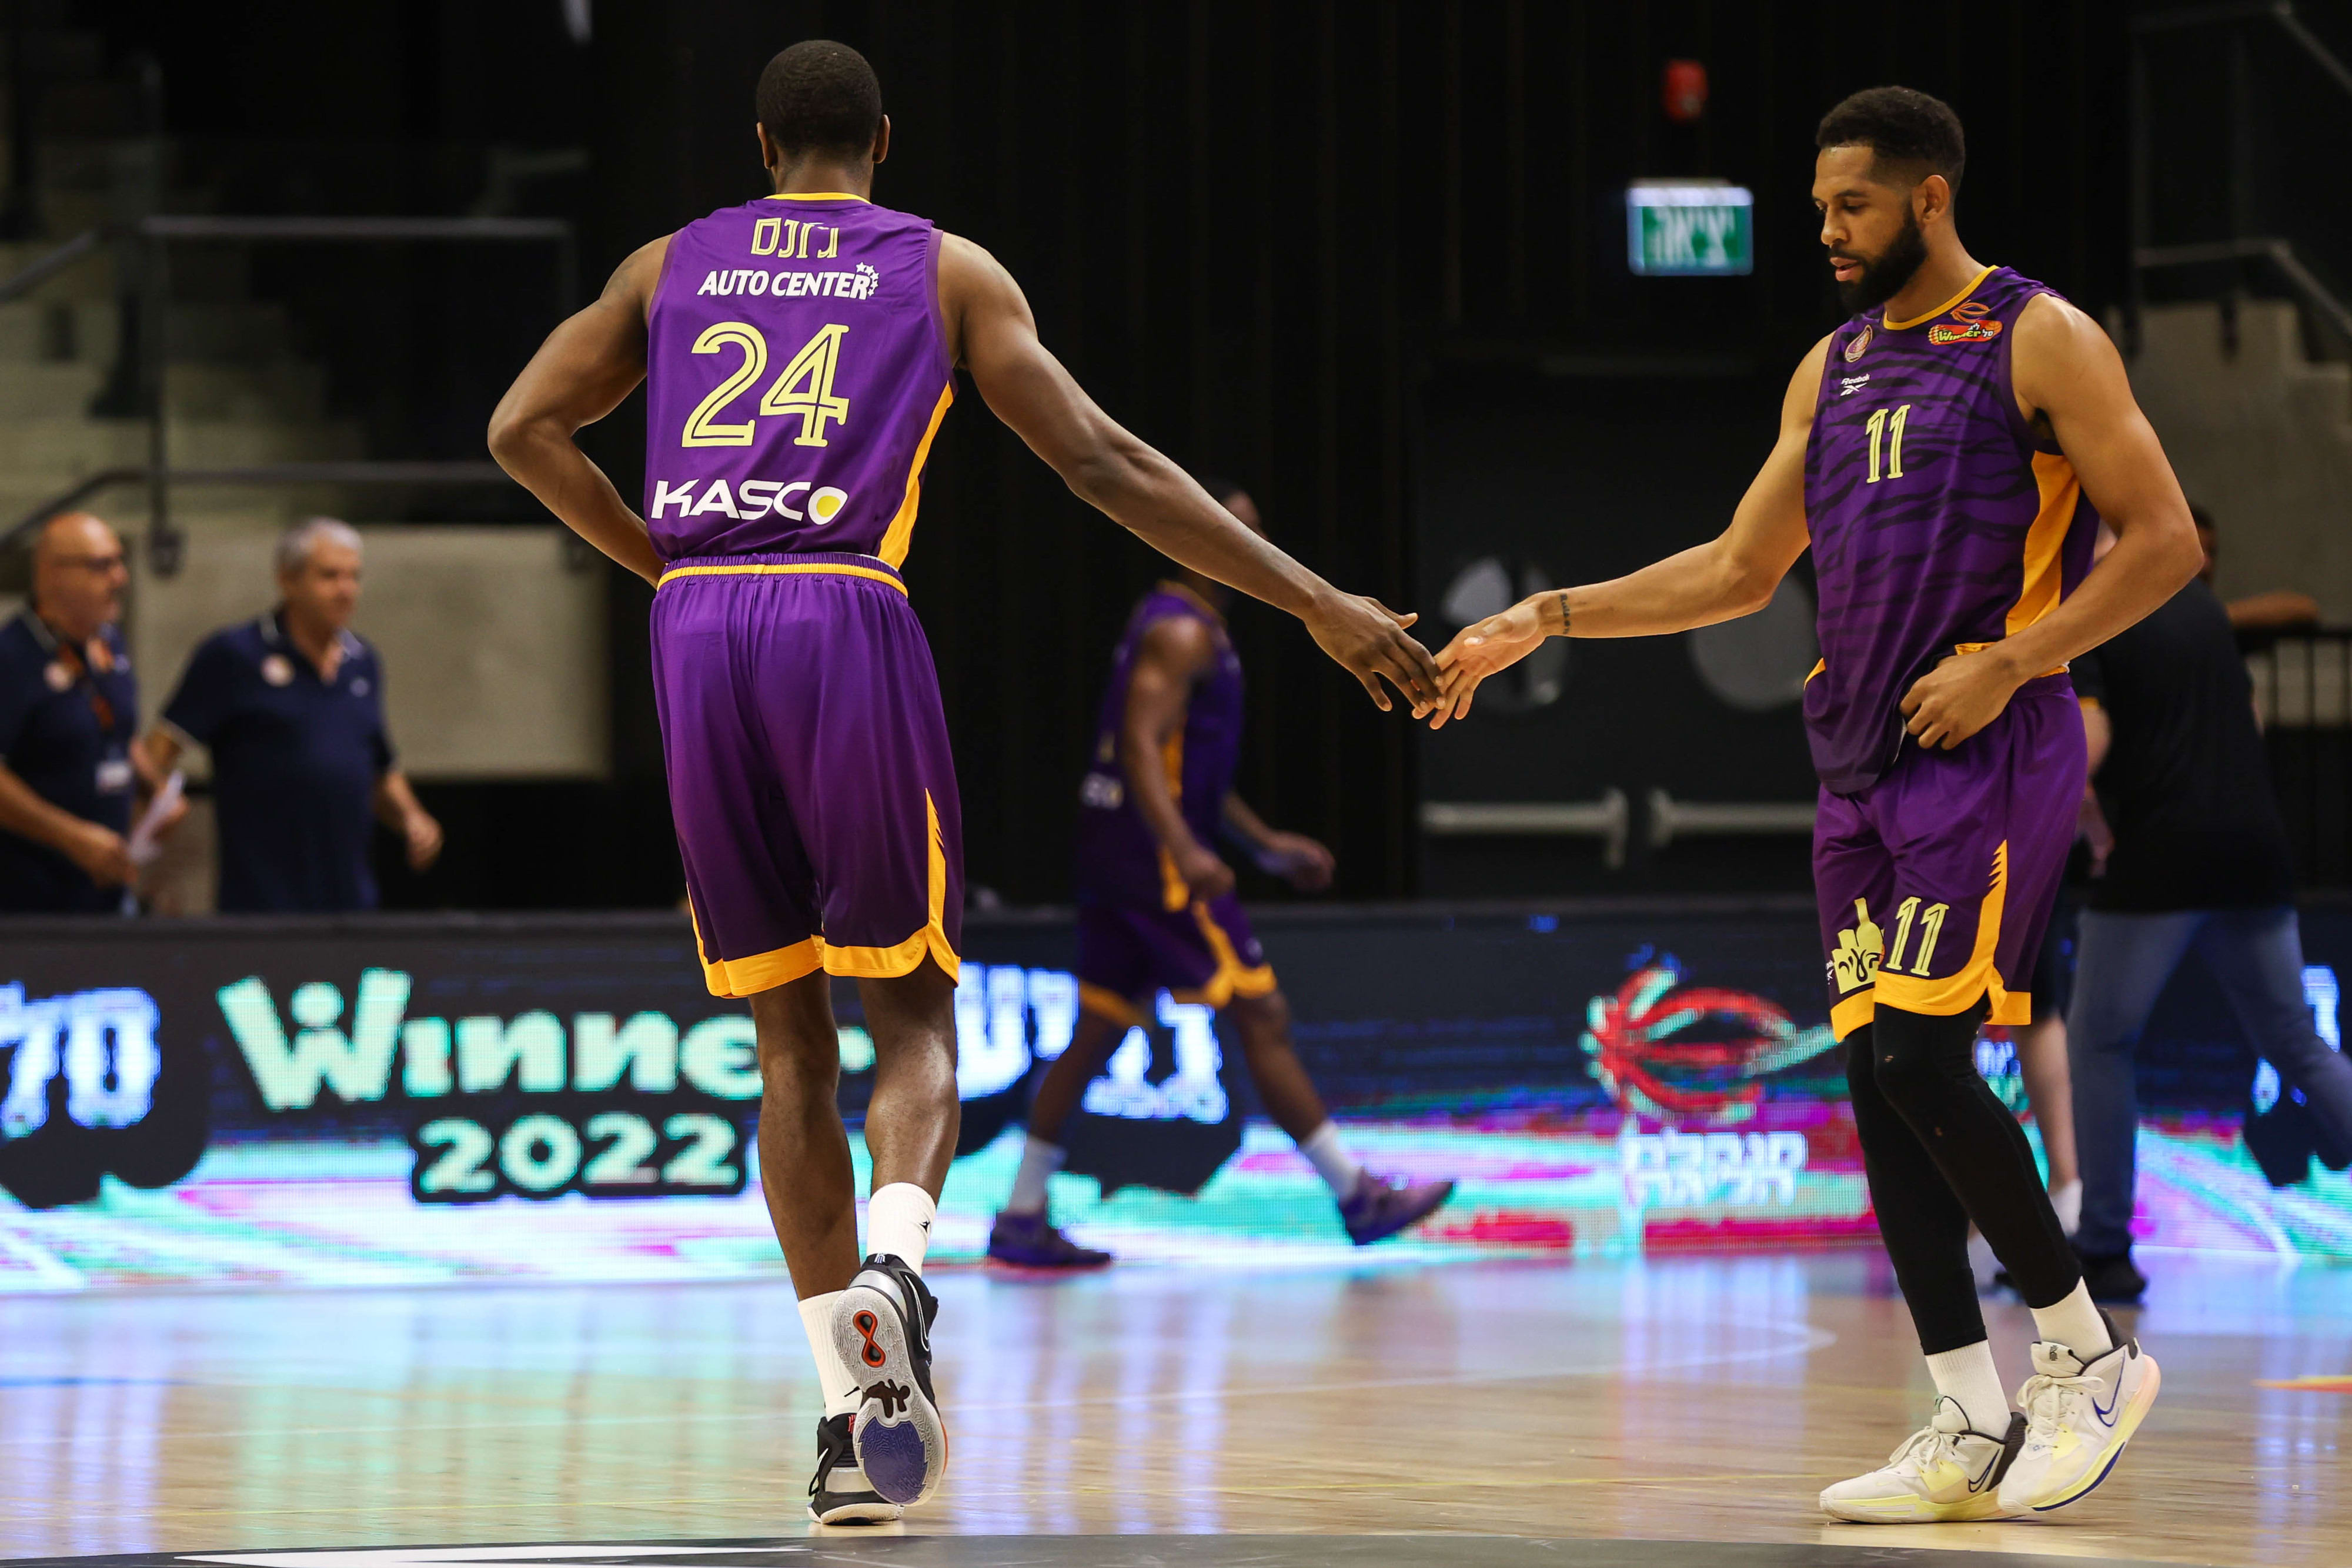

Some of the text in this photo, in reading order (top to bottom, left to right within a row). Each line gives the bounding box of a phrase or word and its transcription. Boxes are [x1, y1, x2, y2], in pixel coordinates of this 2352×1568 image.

[697, 270, 870, 300] AUTO CENTER
[681, 321, 850, 448] 24
[1866, 404, 1911, 483] 11
[651, 479, 848, 526] KASCO
[1886, 897, 1950, 977] 11
[417, 1112, 740, 1193] 2022
